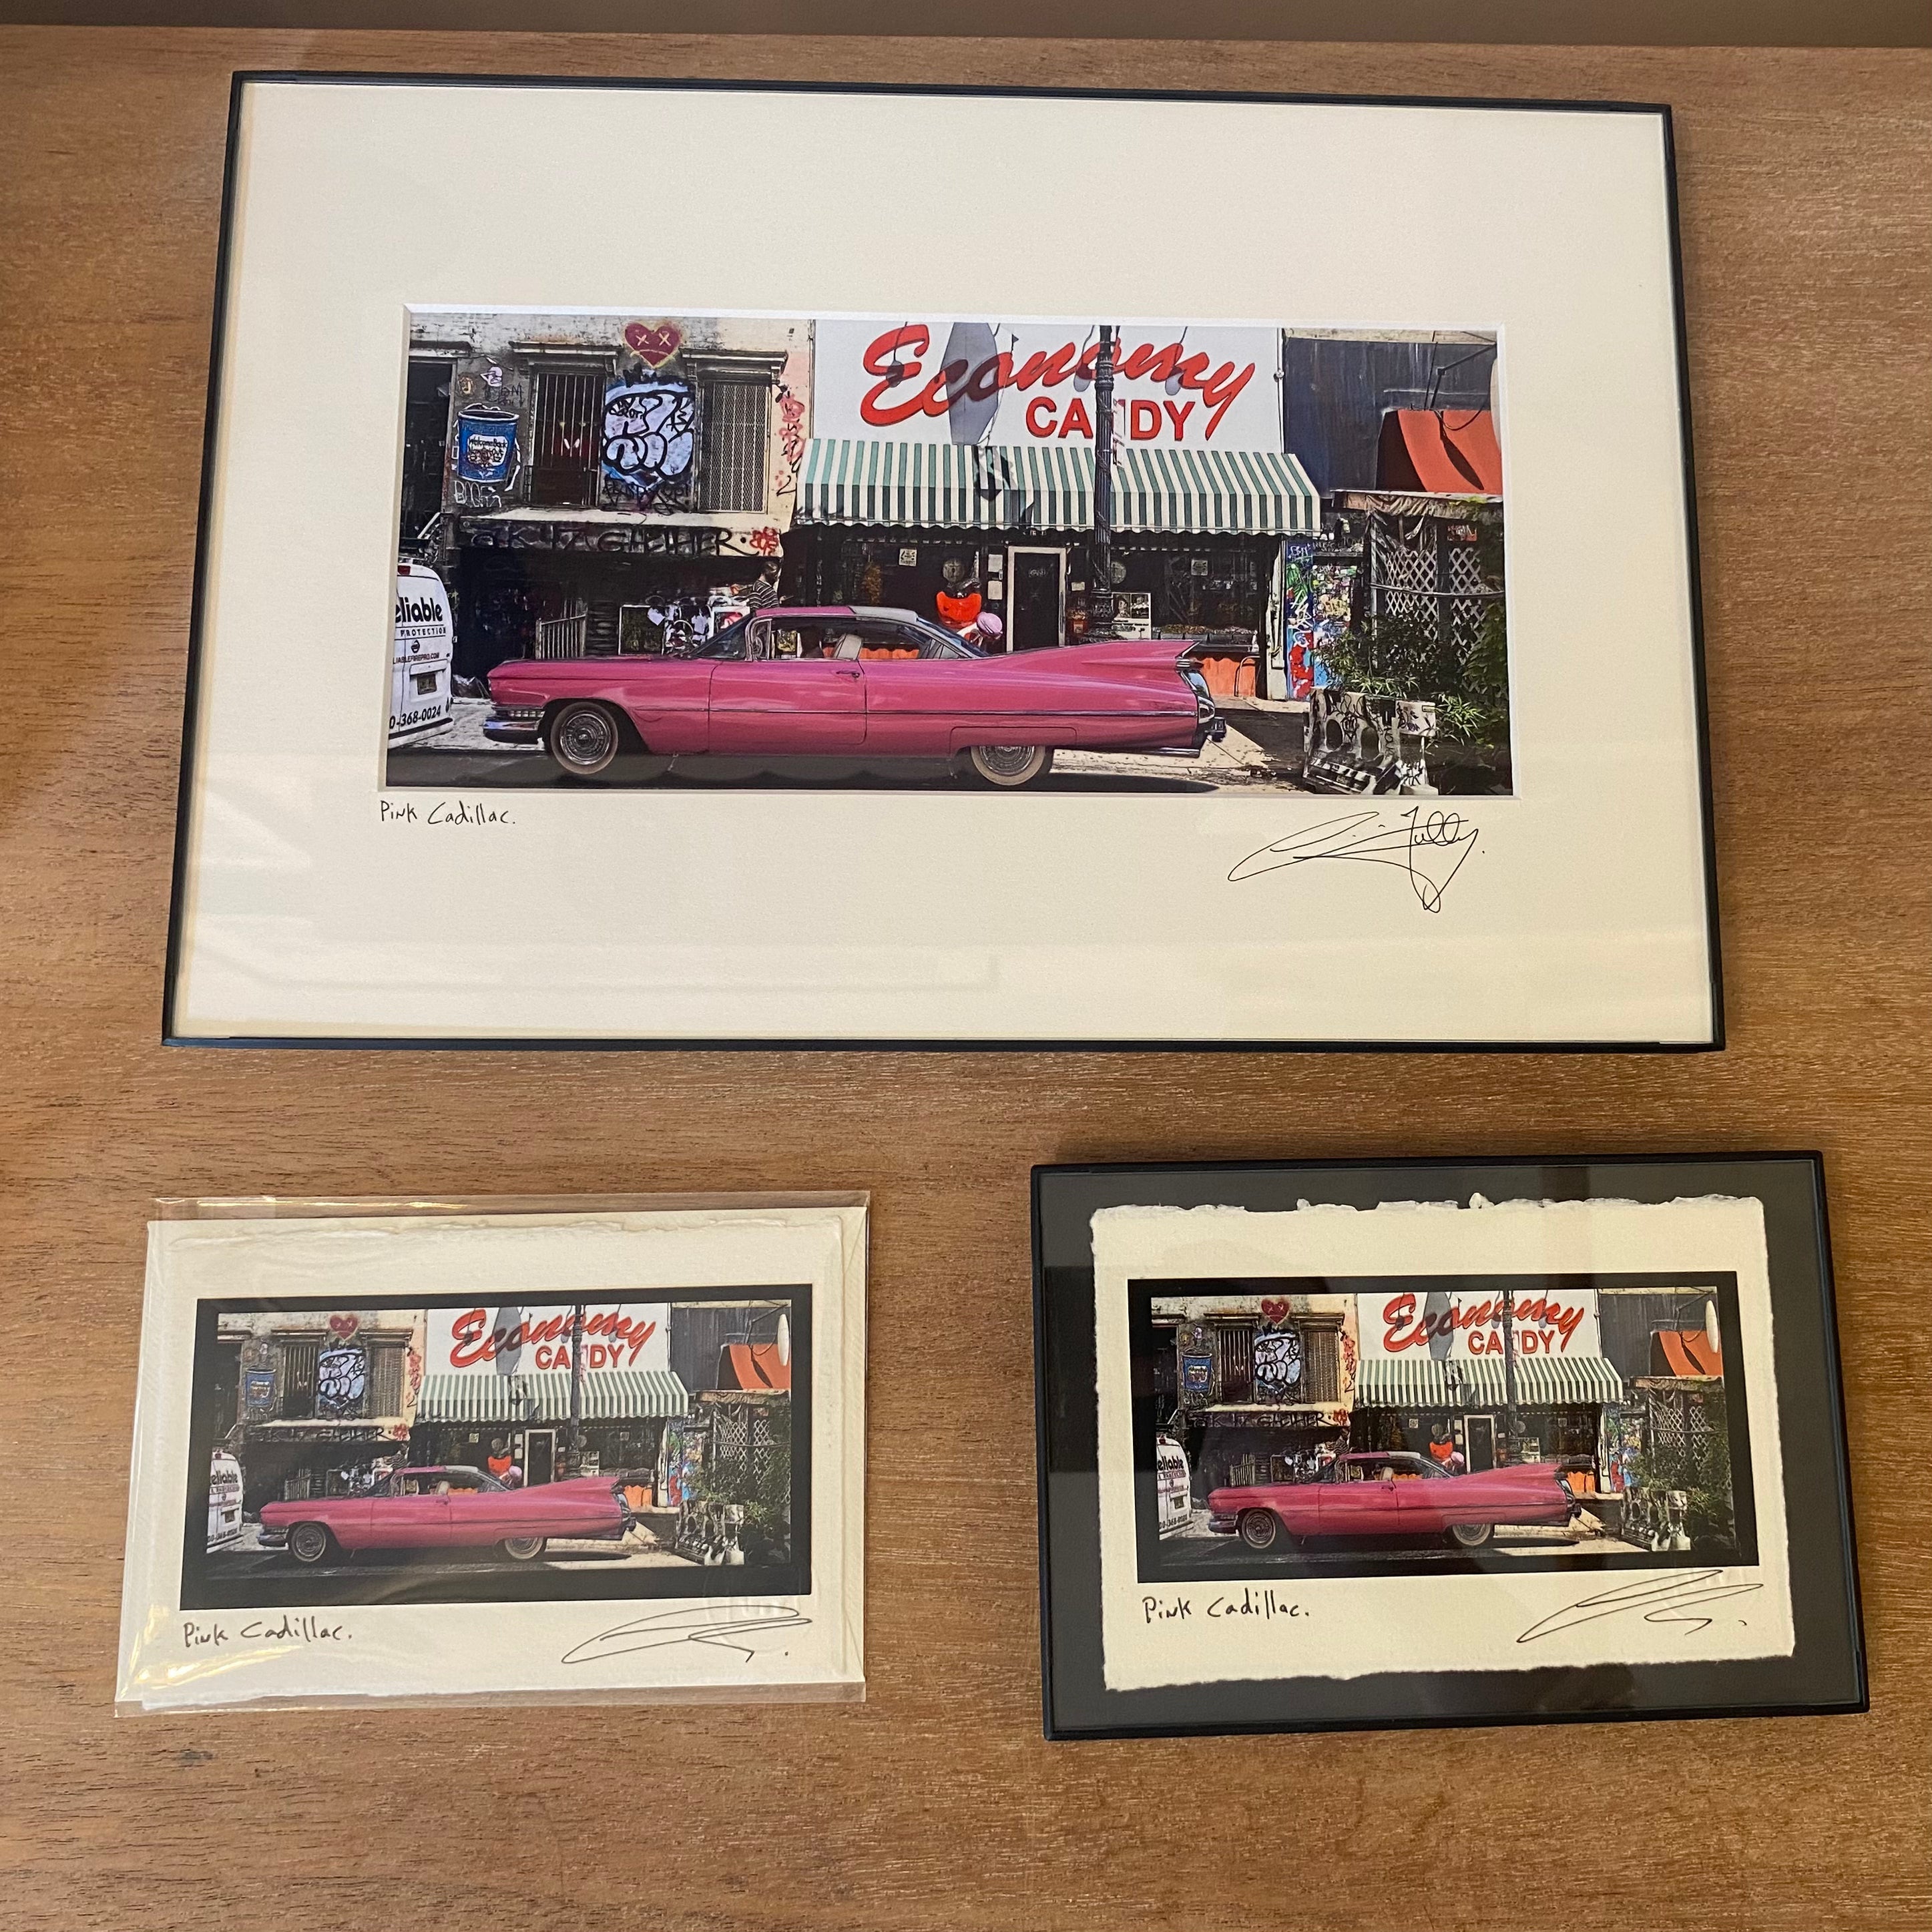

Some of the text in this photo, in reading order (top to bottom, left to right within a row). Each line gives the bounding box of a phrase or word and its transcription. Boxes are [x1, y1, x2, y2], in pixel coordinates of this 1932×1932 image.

[861, 324, 1256, 441] Economy
[1025, 396, 1196, 441] CADY
[401, 627, 446, 637] PROTECTION
[427, 800, 516, 825] Cadillac.
[450, 1308, 656, 1368] Economy
[1383, 1292, 1585, 1353] Economy
[535, 1343, 625, 1370] CADY
[1468, 1330, 1555, 1355] CADY
